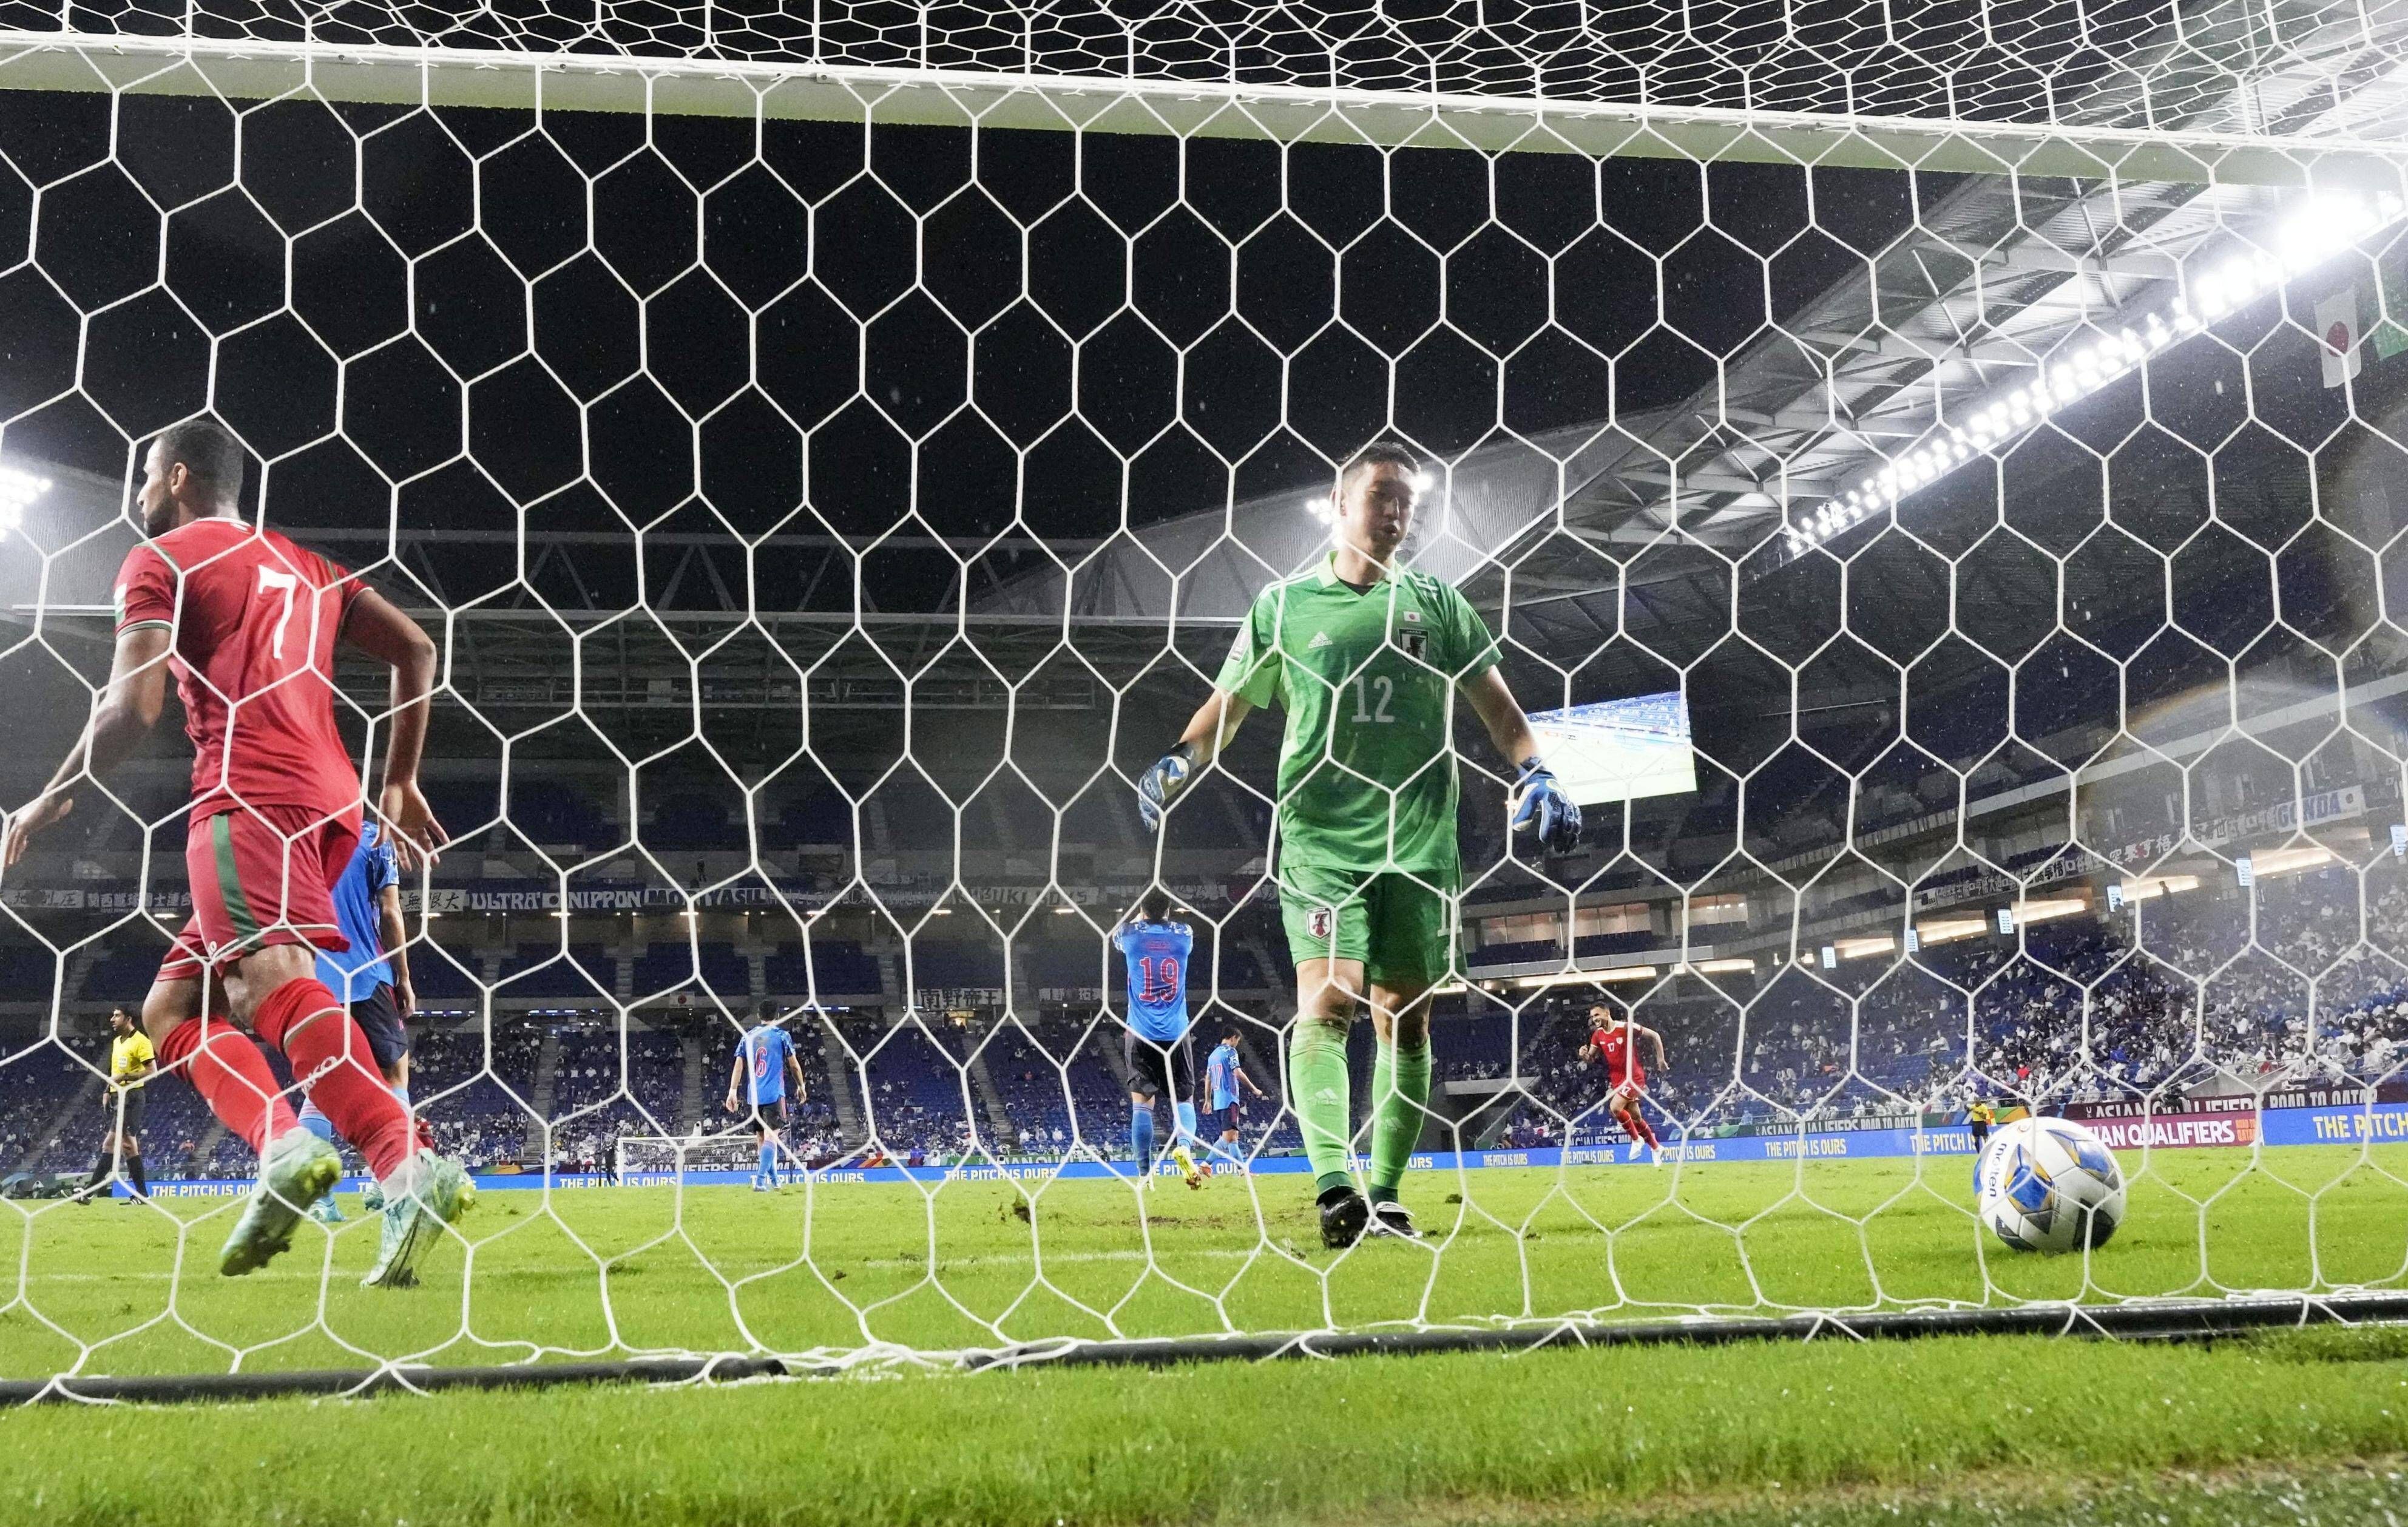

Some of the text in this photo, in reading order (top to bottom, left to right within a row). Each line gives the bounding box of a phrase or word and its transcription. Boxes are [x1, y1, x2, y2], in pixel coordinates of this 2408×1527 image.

[257, 564, 297, 660] 7
[1351, 675, 1395, 723] 12
[567, 890, 642, 909] NIPPON
[1138, 956, 1179, 1003] 19
[1607, 1042, 1615, 1052] 17
[2127, 1120, 2236, 1146] QUALIFIERS
[2313, 1114, 2351, 1139] THE
[1765, 1142, 1783, 1157] THE
[1810, 1140, 1819, 1155] IS
[1821, 1138, 1847, 1155] OURS
[1933, 1133, 1966, 1151] PITCH
[1483, 1153, 1528, 1167] THE PITCH IS OURS
[1597, 1149, 1614, 1163] OURS
[1687, 1146, 1694, 1160] IS
[1695, 1144, 1716, 1160] OURS
[1408, 1157, 1433, 1169] URS
[1988, 1142, 2007, 1197] molten
[560, 1178, 583, 1188] THE
[627, 1177, 638, 1187] IS
[642, 1176, 677, 1187] OURS
[831, 1173, 865, 1183] OURS
[152, 1185, 177, 1197] THE
[180, 1184, 218, 1196] PITCH
[220, 1184, 234, 1196] IS
